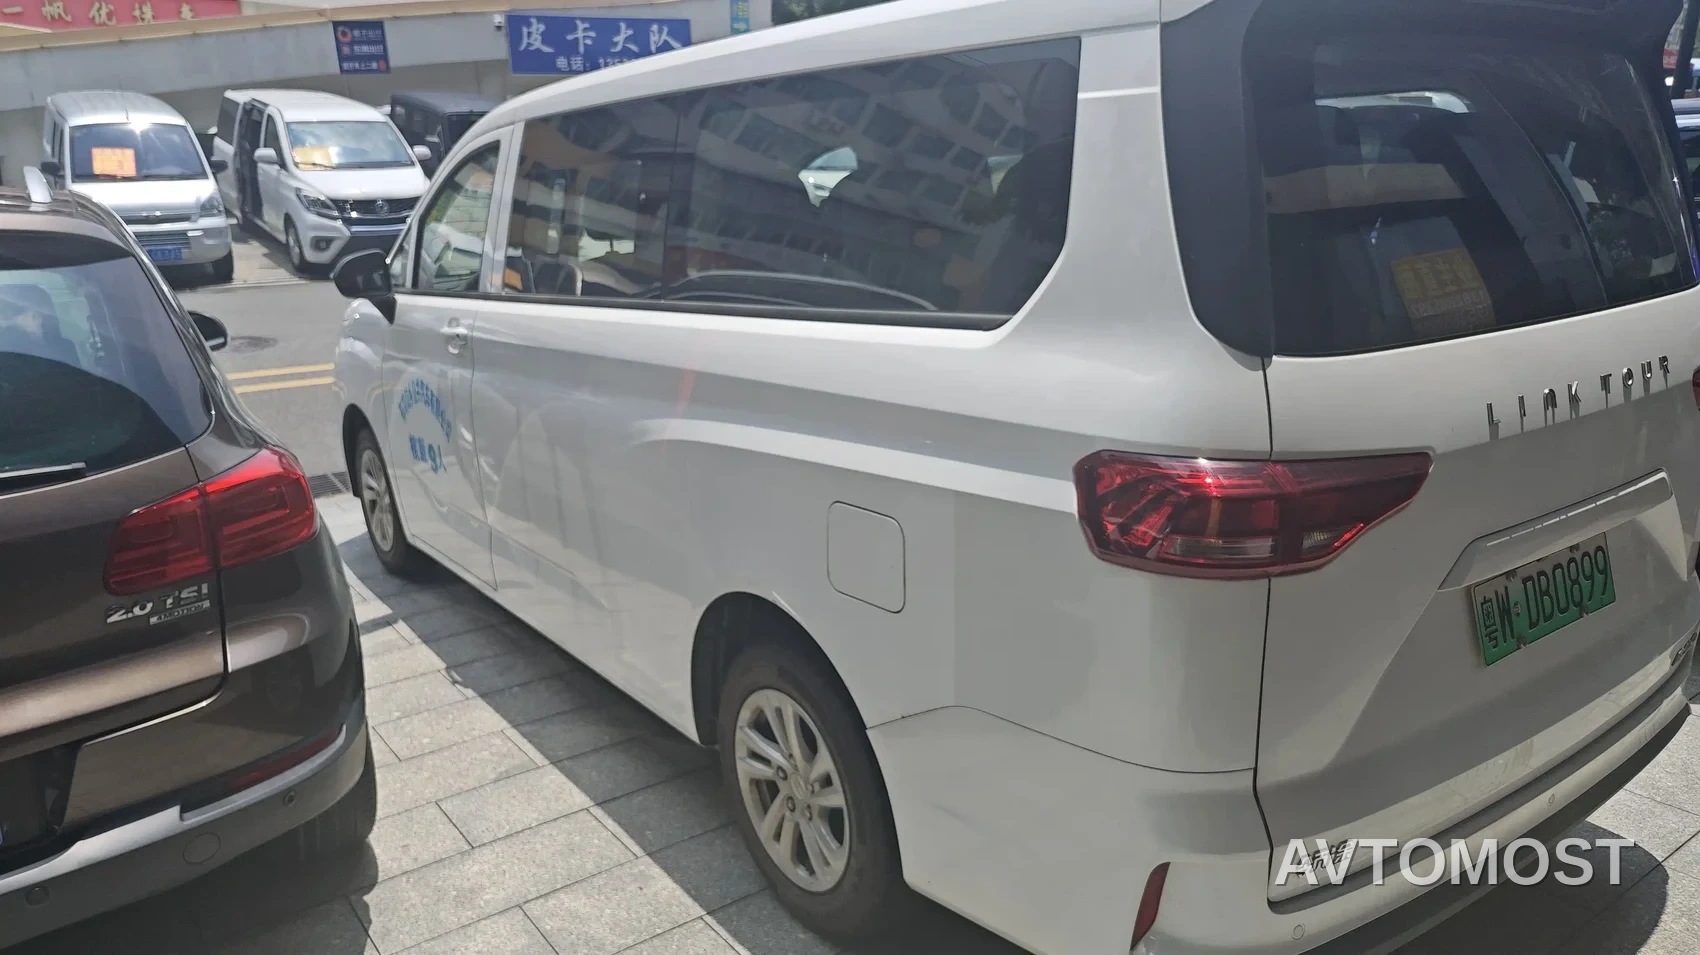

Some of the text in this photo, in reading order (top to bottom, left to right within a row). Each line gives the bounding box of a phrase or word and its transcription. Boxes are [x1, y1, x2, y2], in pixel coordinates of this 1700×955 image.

[519, 18, 682, 53] 皮卡大队
[1486, 355, 1671, 426] LINK TOUR
[105, 582, 209, 624] 2.0 TSI
